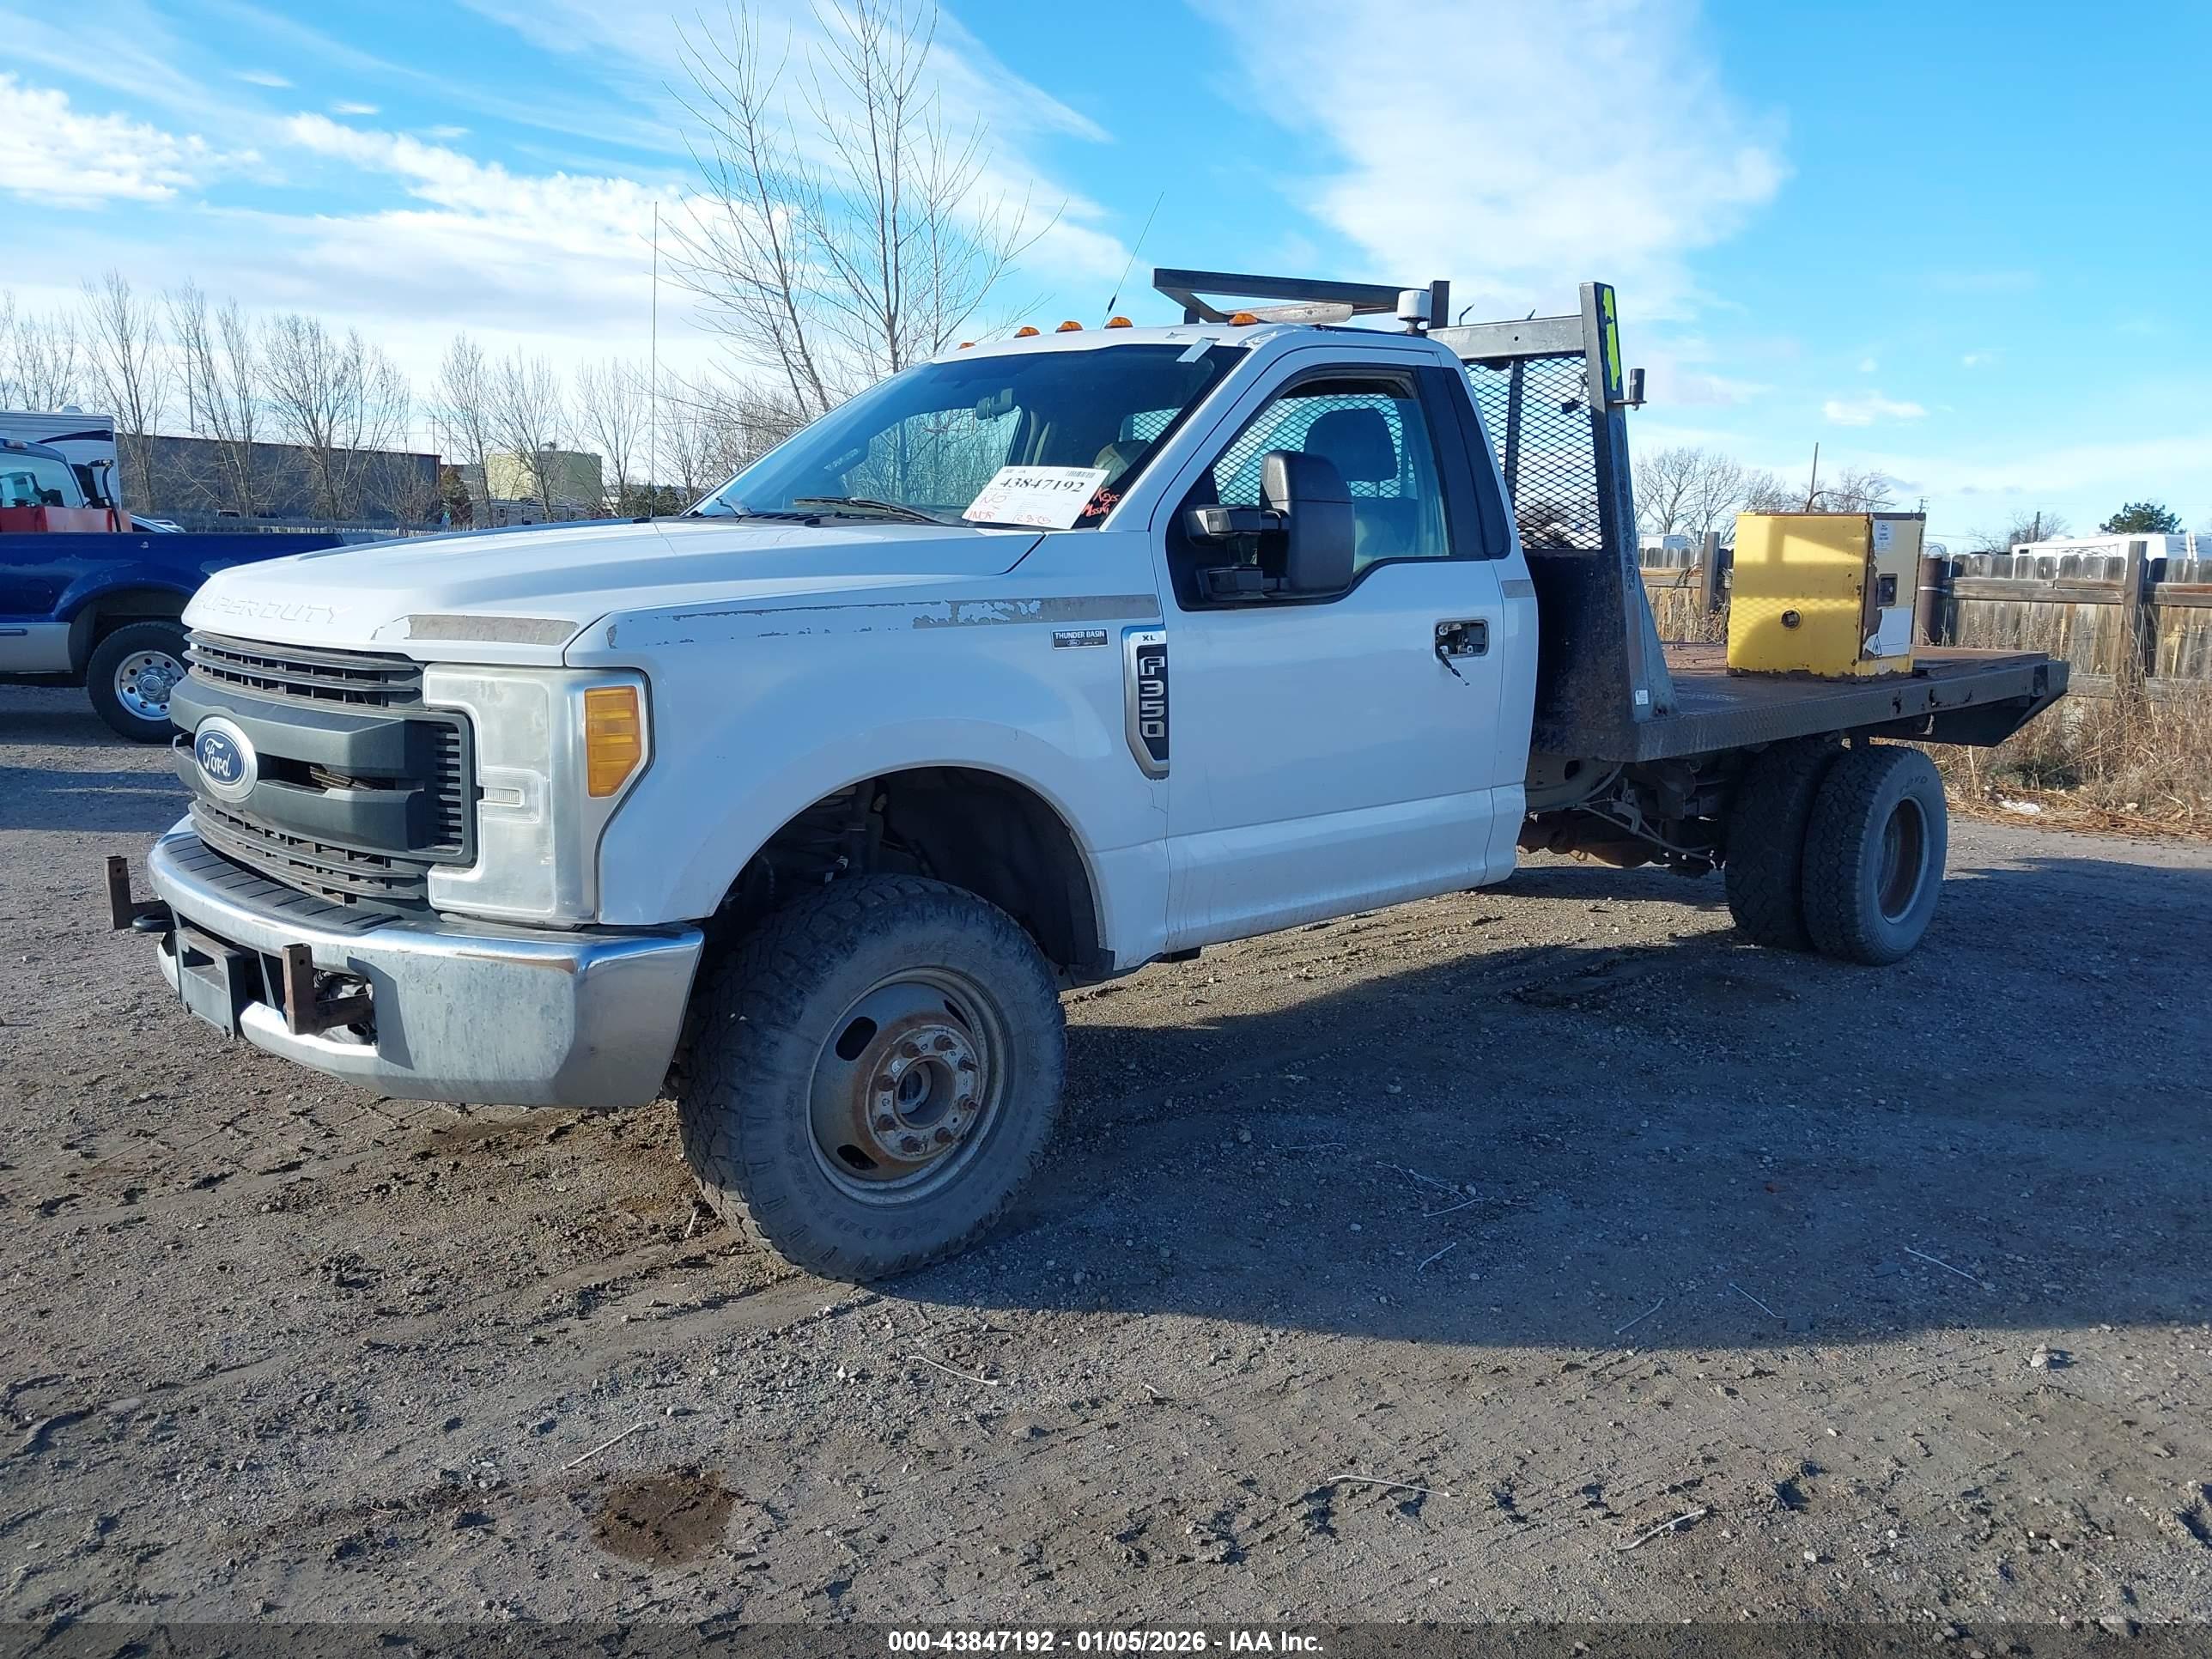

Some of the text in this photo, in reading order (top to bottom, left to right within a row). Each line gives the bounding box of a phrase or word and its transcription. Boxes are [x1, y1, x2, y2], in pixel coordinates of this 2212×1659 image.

[1000, 477, 1085, 493] 43847192
[260, 600, 353, 626] DUTY
[1086, 629, 1105, 638] BASIN
[204, 737, 232, 777] Ford
